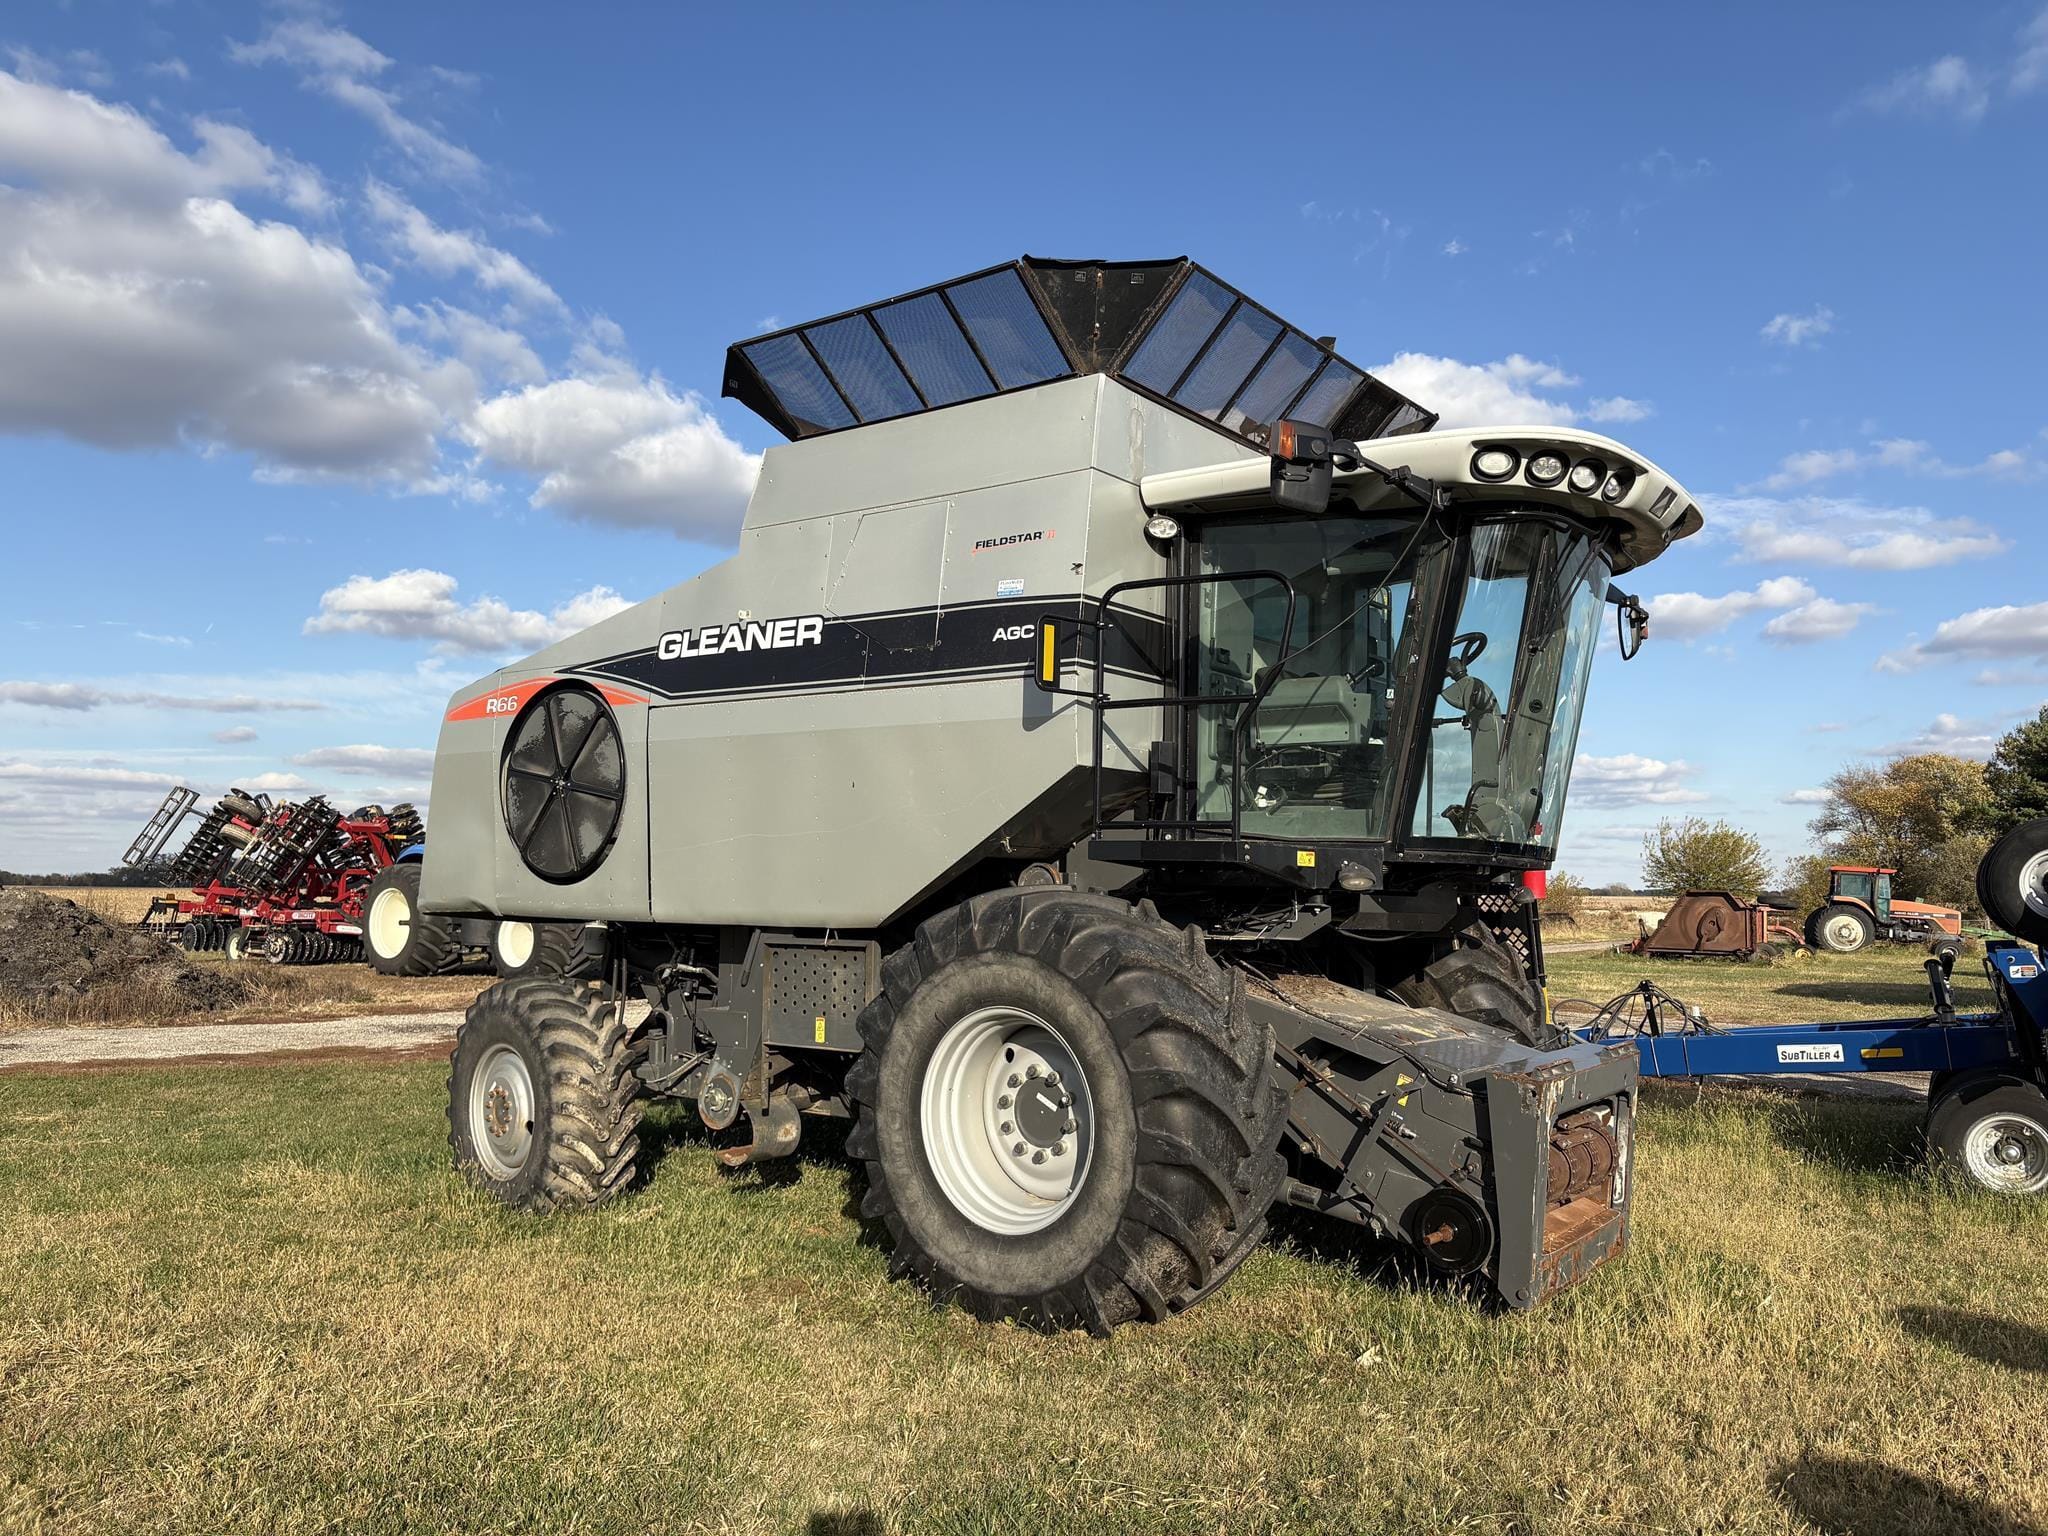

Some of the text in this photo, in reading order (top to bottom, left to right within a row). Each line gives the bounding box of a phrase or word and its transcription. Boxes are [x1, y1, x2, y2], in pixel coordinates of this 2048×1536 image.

[975, 532, 1042, 549] FIELDSTAR
[657, 615, 825, 661] GLEANER
[992, 625, 1035, 642] AGC
[486, 696, 518, 713] R66
[1833, 1050, 1840, 1059] 4
